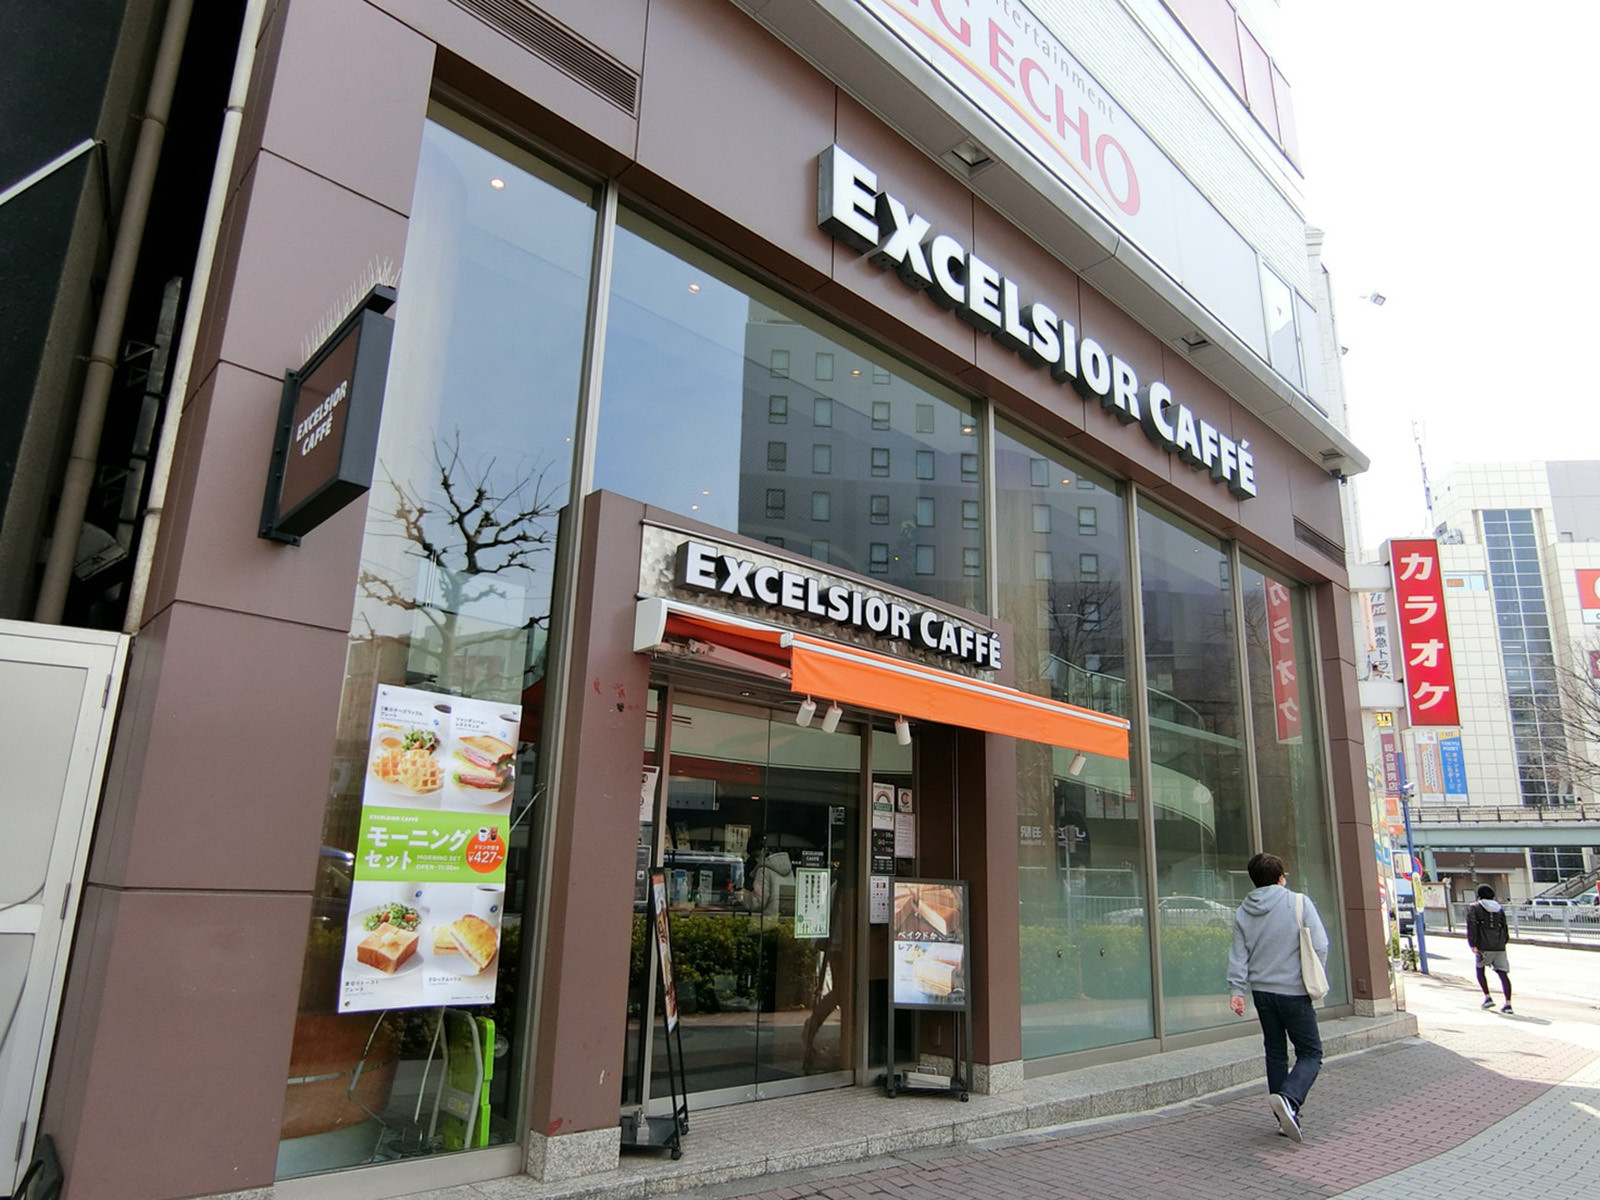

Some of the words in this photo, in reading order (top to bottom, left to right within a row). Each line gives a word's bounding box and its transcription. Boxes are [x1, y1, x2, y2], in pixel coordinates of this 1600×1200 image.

[988, 17, 1141, 216] ECHO
[995, 0, 1115, 124] tertainment
[832, 143, 1141, 422] EXCELSIOR
[1147, 380, 1257, 498] CAFFÉ
[296, 380, 348, 442] EXCELSIOR
[302, 412, 333, 456] CAFFÉ
[685, 540, 912, 641] EXCELSIOR
[920, 611, 1002, 670] CAFFÉ
[1400, 552, 1450, 711] カラオケ
[364, 849, 412, 871] セット
[366, 826, 472, 852] モーニング
